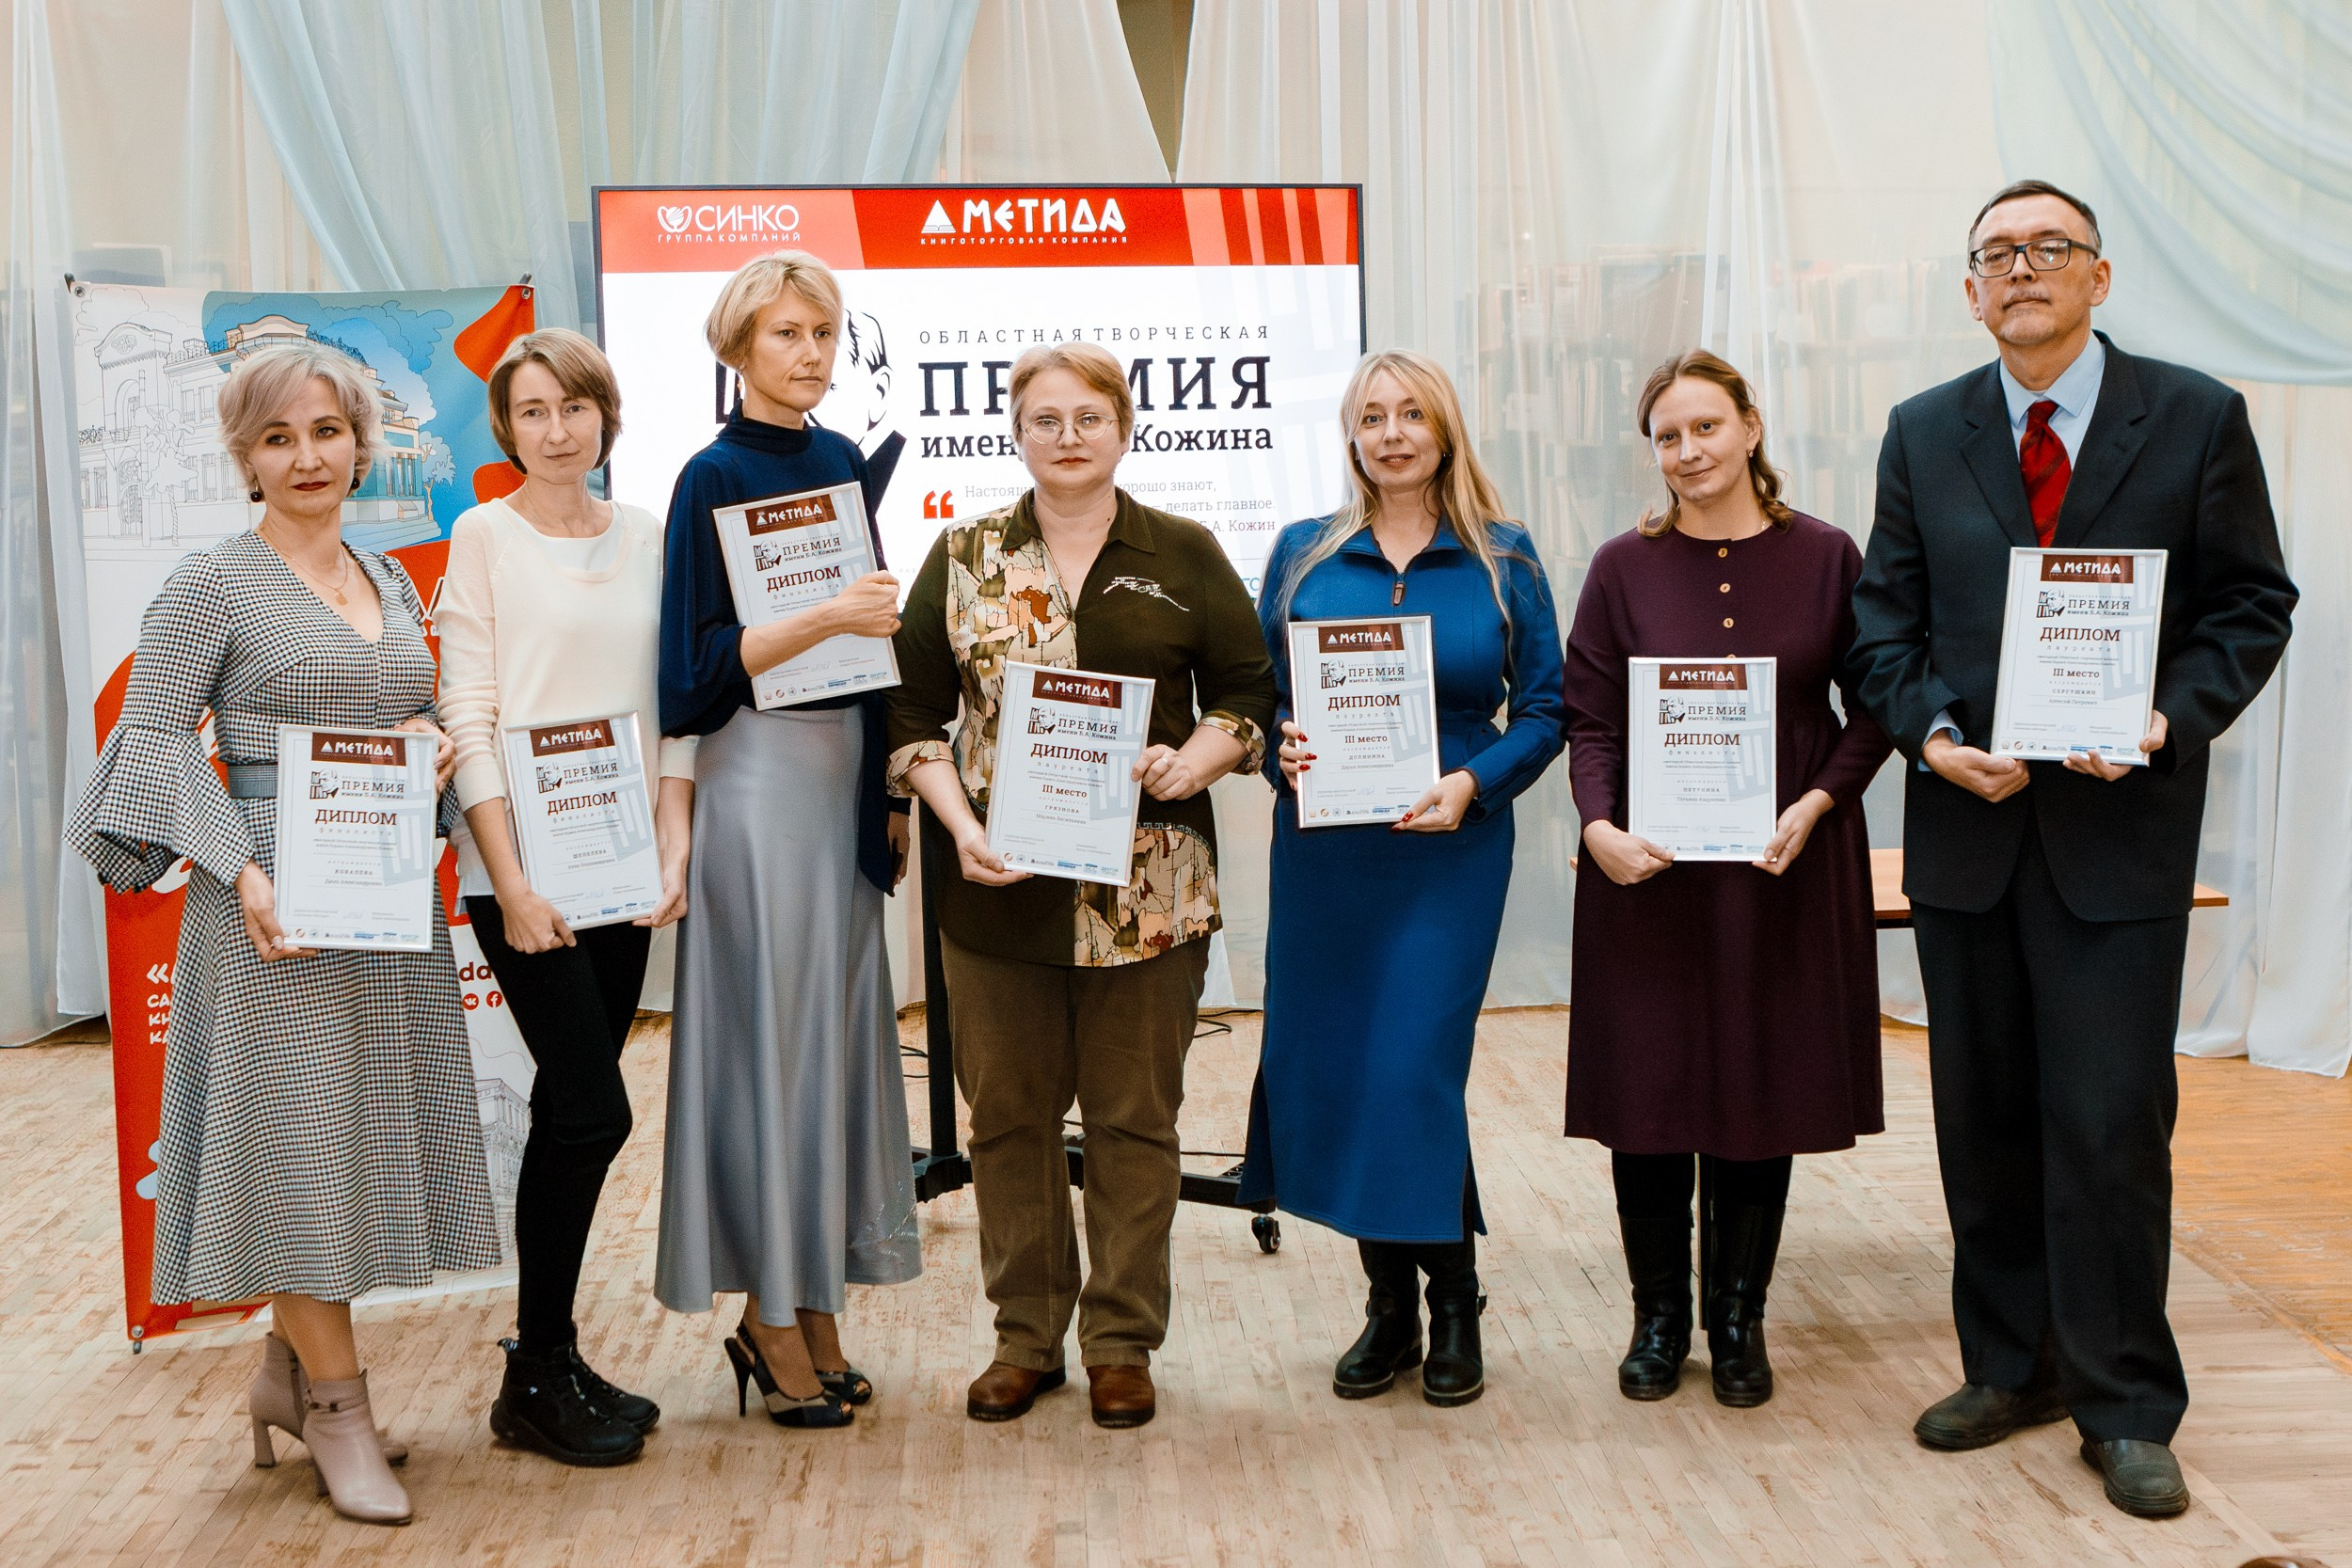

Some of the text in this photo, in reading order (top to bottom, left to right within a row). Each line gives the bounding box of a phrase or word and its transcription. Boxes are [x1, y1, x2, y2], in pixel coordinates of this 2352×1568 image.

[695, 205, 800, 232] СИНКО
[962, 198, 1126, 233] МЕТИДА
[659, 231, 801, 243] ГРУППА КОМПАНИЙ
[920, 326, 1267, 343] ОБЛАСТНАЯ ТВОРЧЕСКАЯ
[918, 356, 1272, 417] ПРМИЯ
[921, 424, 1273, 458] имен Кожина
[965, 485, 1034, 498] Настоящ
[1170, 482, 1216, 492] знают,
[769, 503, 823, 524] МЕТИДА
[1166, 502, 1214, 513] делать
[1229, 520, 1276, 531] Кожин
[783, 537, 841, 556] ПРЕМИЯ
[2064, 562, 2122, 575] МЕТИДА
[767, 566, 842, 594] ДИПЛОМ
[2068, 600, 2130, 610] ПРЕМИЯ
[1340, 632, 1392, 644] МЕТИДА
[2040, 627, 2121, 642] ДИПЛОМ
[1348, 667, 1405, 677] ПРЕМИЯ
[1681, 671, 1735, 682] МЕТИДА
[2053, 668, 2100, 678] III место
[1056, 681, 1110, 699] МЕТИДА
[1328, 694, 1401, 711] ДИПЛОМ
[1688, 706, 1746, 715] ПРЕМИЯ
[1057, 719, 1118, 735] ПРЕМИЯ
[551, 728, 603, 746] МЕТИДА
[1345, 736, 1356, 744] III
[1664, 734, 1740, 748] ДИПЛОМ
[335, 741, 394, 756] МЕТИДА
[1031, 743, 1108, 765] ДИПЛОМ
[564, 762, 618, 779] ПРЕМИЯ
[342, 781, 405, 793] ПРЕМИЯ
[1042, 784, 1088, 798] III место
[548, 791, 617, 816] ДИПЛОМ
[314, 809, 397, 826] ДИПЛОМ
